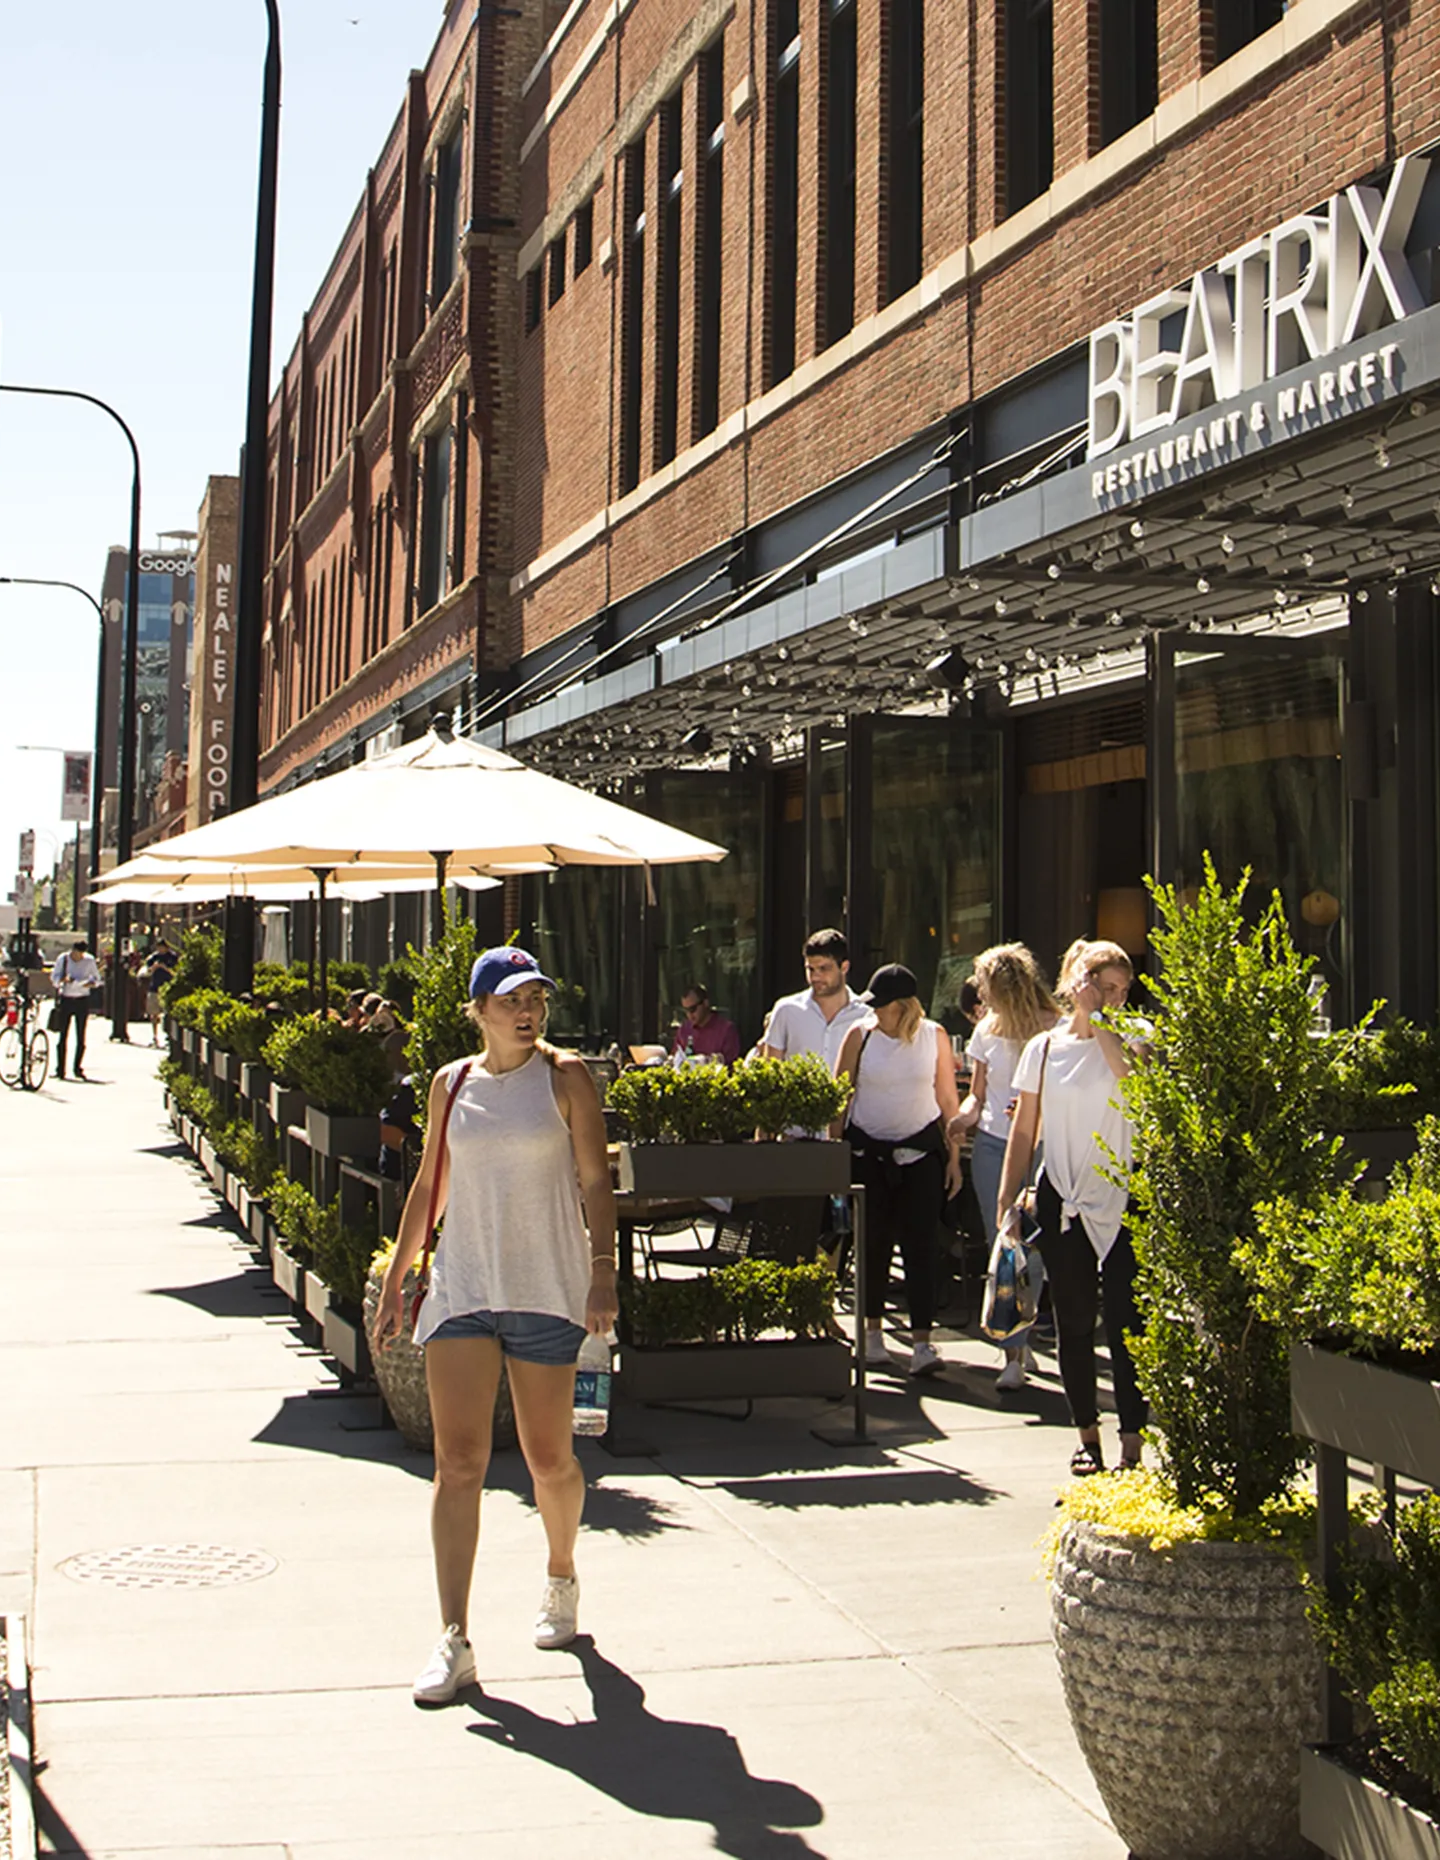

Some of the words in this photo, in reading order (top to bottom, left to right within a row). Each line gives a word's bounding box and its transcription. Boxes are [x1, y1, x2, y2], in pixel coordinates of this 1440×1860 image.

[1088, 155, 1430, 460] BEATRIX
[1091, 409, 1244, 499] RESTAURANT
[1249, 400, 1266, 432] &
[1276, 343, 1401, 422] MARKET
[212, 563, 232, 704] NEALEY
[207, 719, 228, 823] FOOD
